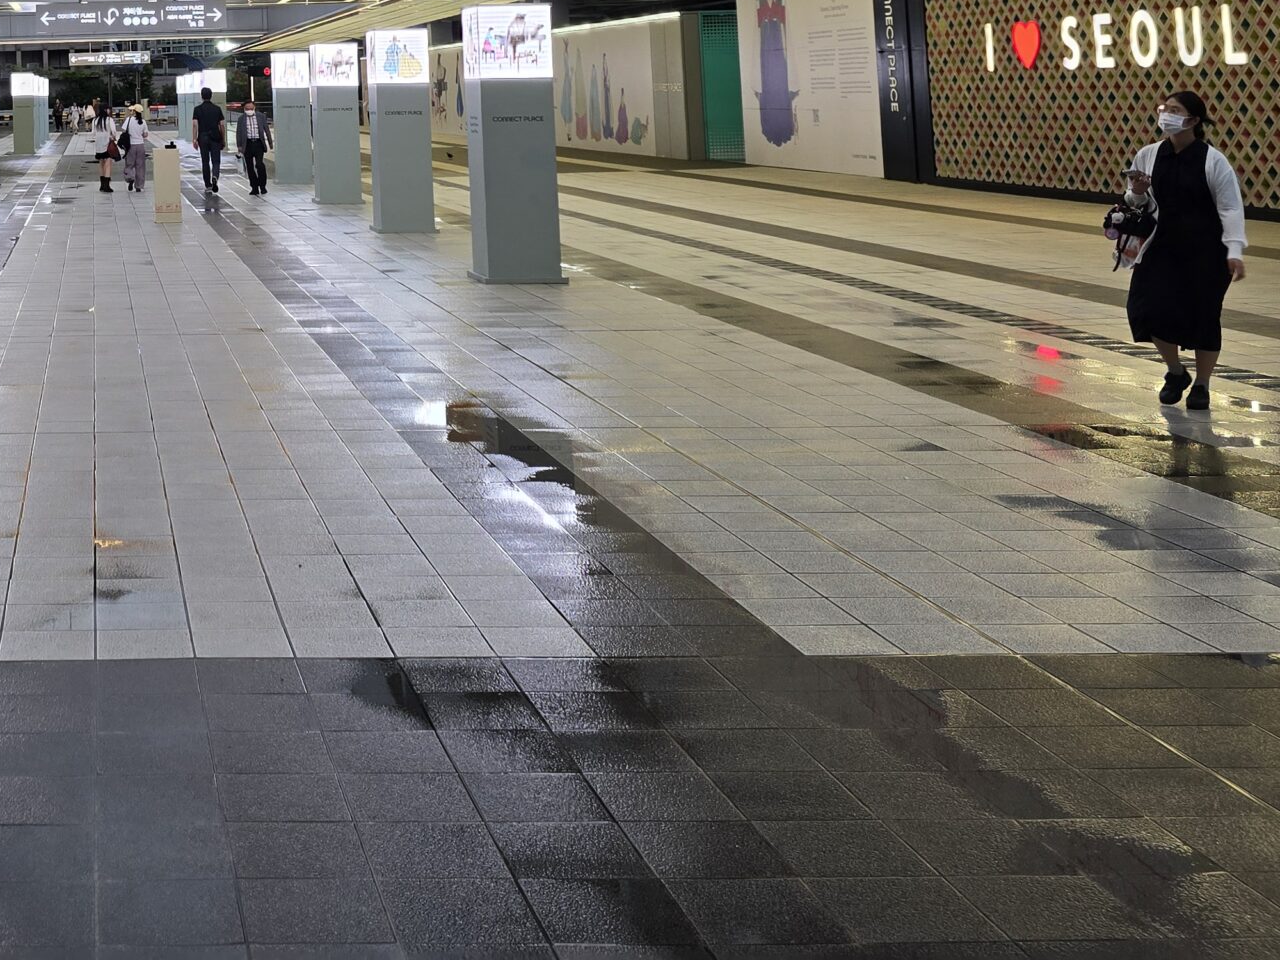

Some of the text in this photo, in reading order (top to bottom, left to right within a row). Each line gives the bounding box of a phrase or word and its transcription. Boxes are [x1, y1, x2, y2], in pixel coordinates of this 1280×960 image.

[984, 3, 1249, 72] I SEOUL
[887, 54, 899, 113] PLACE
